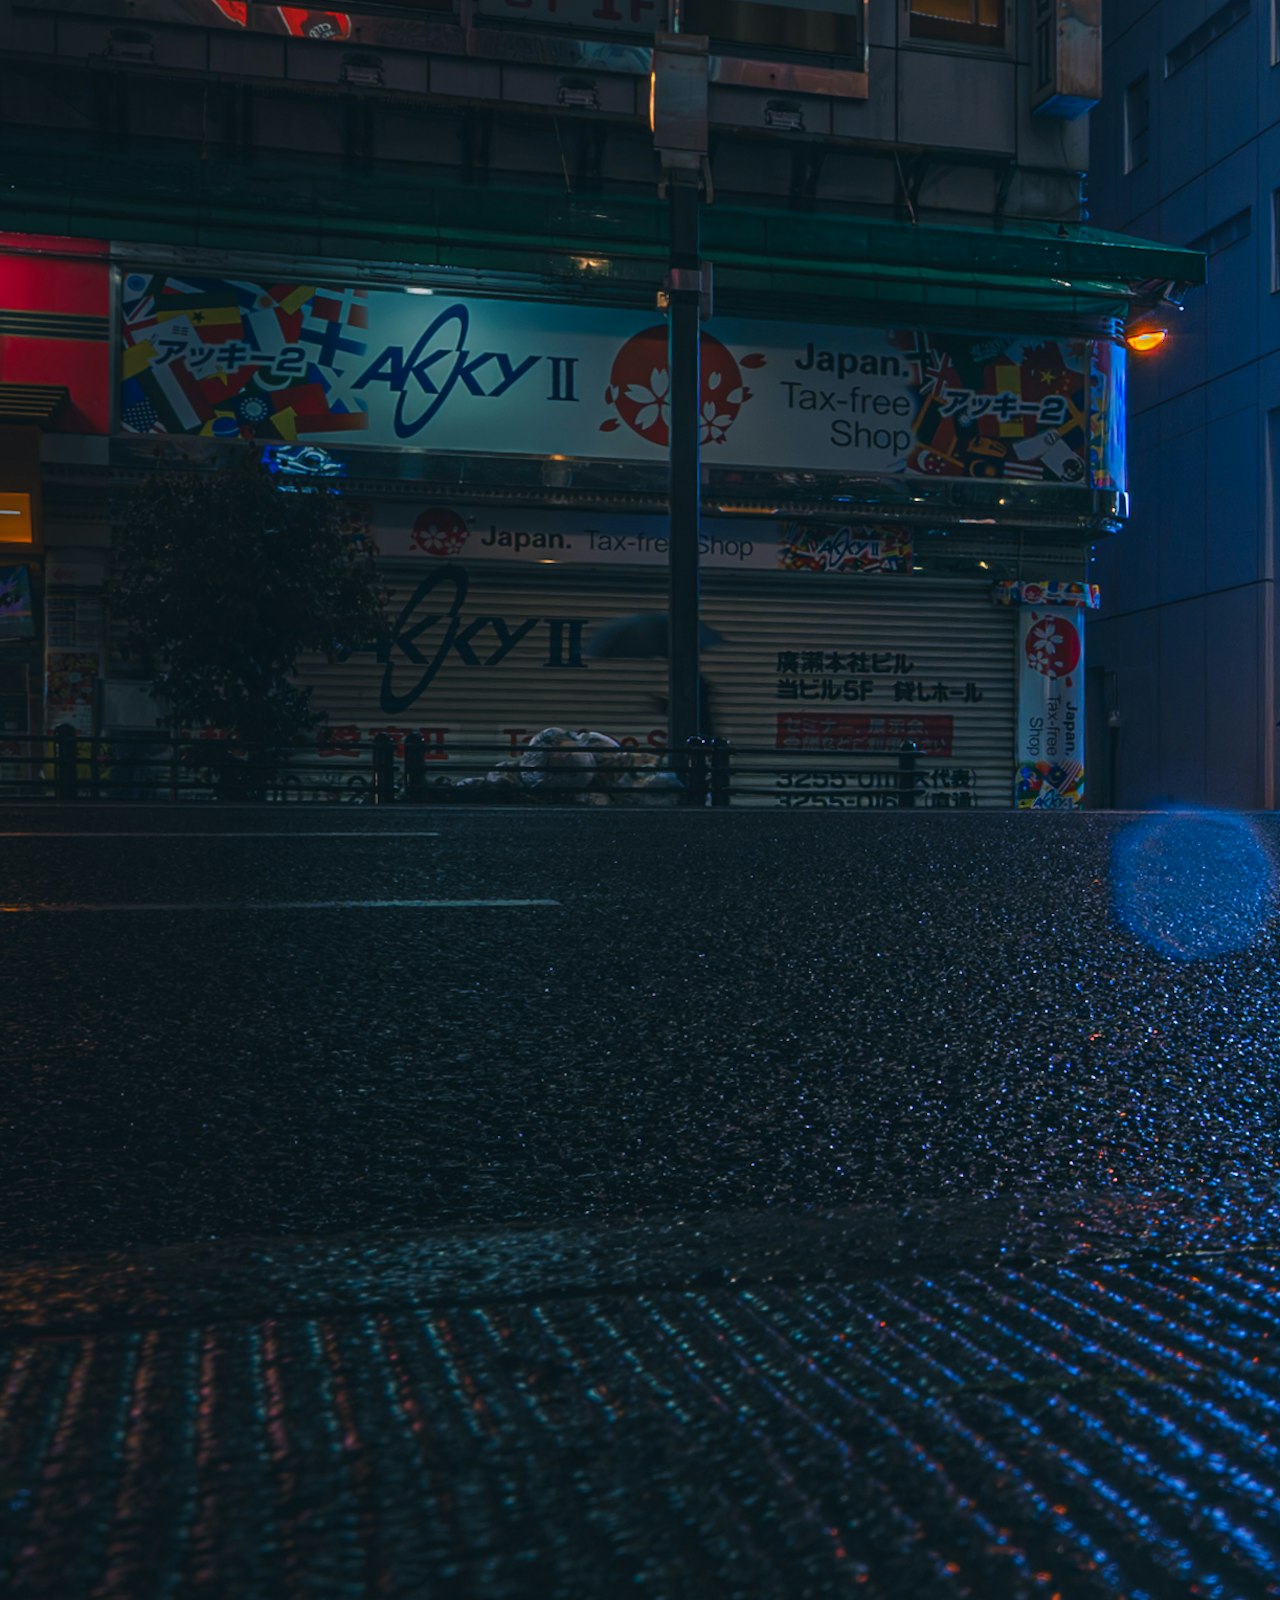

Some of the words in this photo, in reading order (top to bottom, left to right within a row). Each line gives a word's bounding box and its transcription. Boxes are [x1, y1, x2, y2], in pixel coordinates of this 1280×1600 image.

[155, 338, 306, 374] アッキー2
[351, 303, 543, 439] AKKY
[795, 343, 910, 382] Japan.
[780, 381, 911, 418] Tax-free
[939, 391, 1067, 425] アッキー2
[829, 419, 911, 458] Shop
[480, 524, 572, 556] Japan.
[587, 530, 669, 554] Tax-fre
[891, 681, 984, 704] 貸しホール
